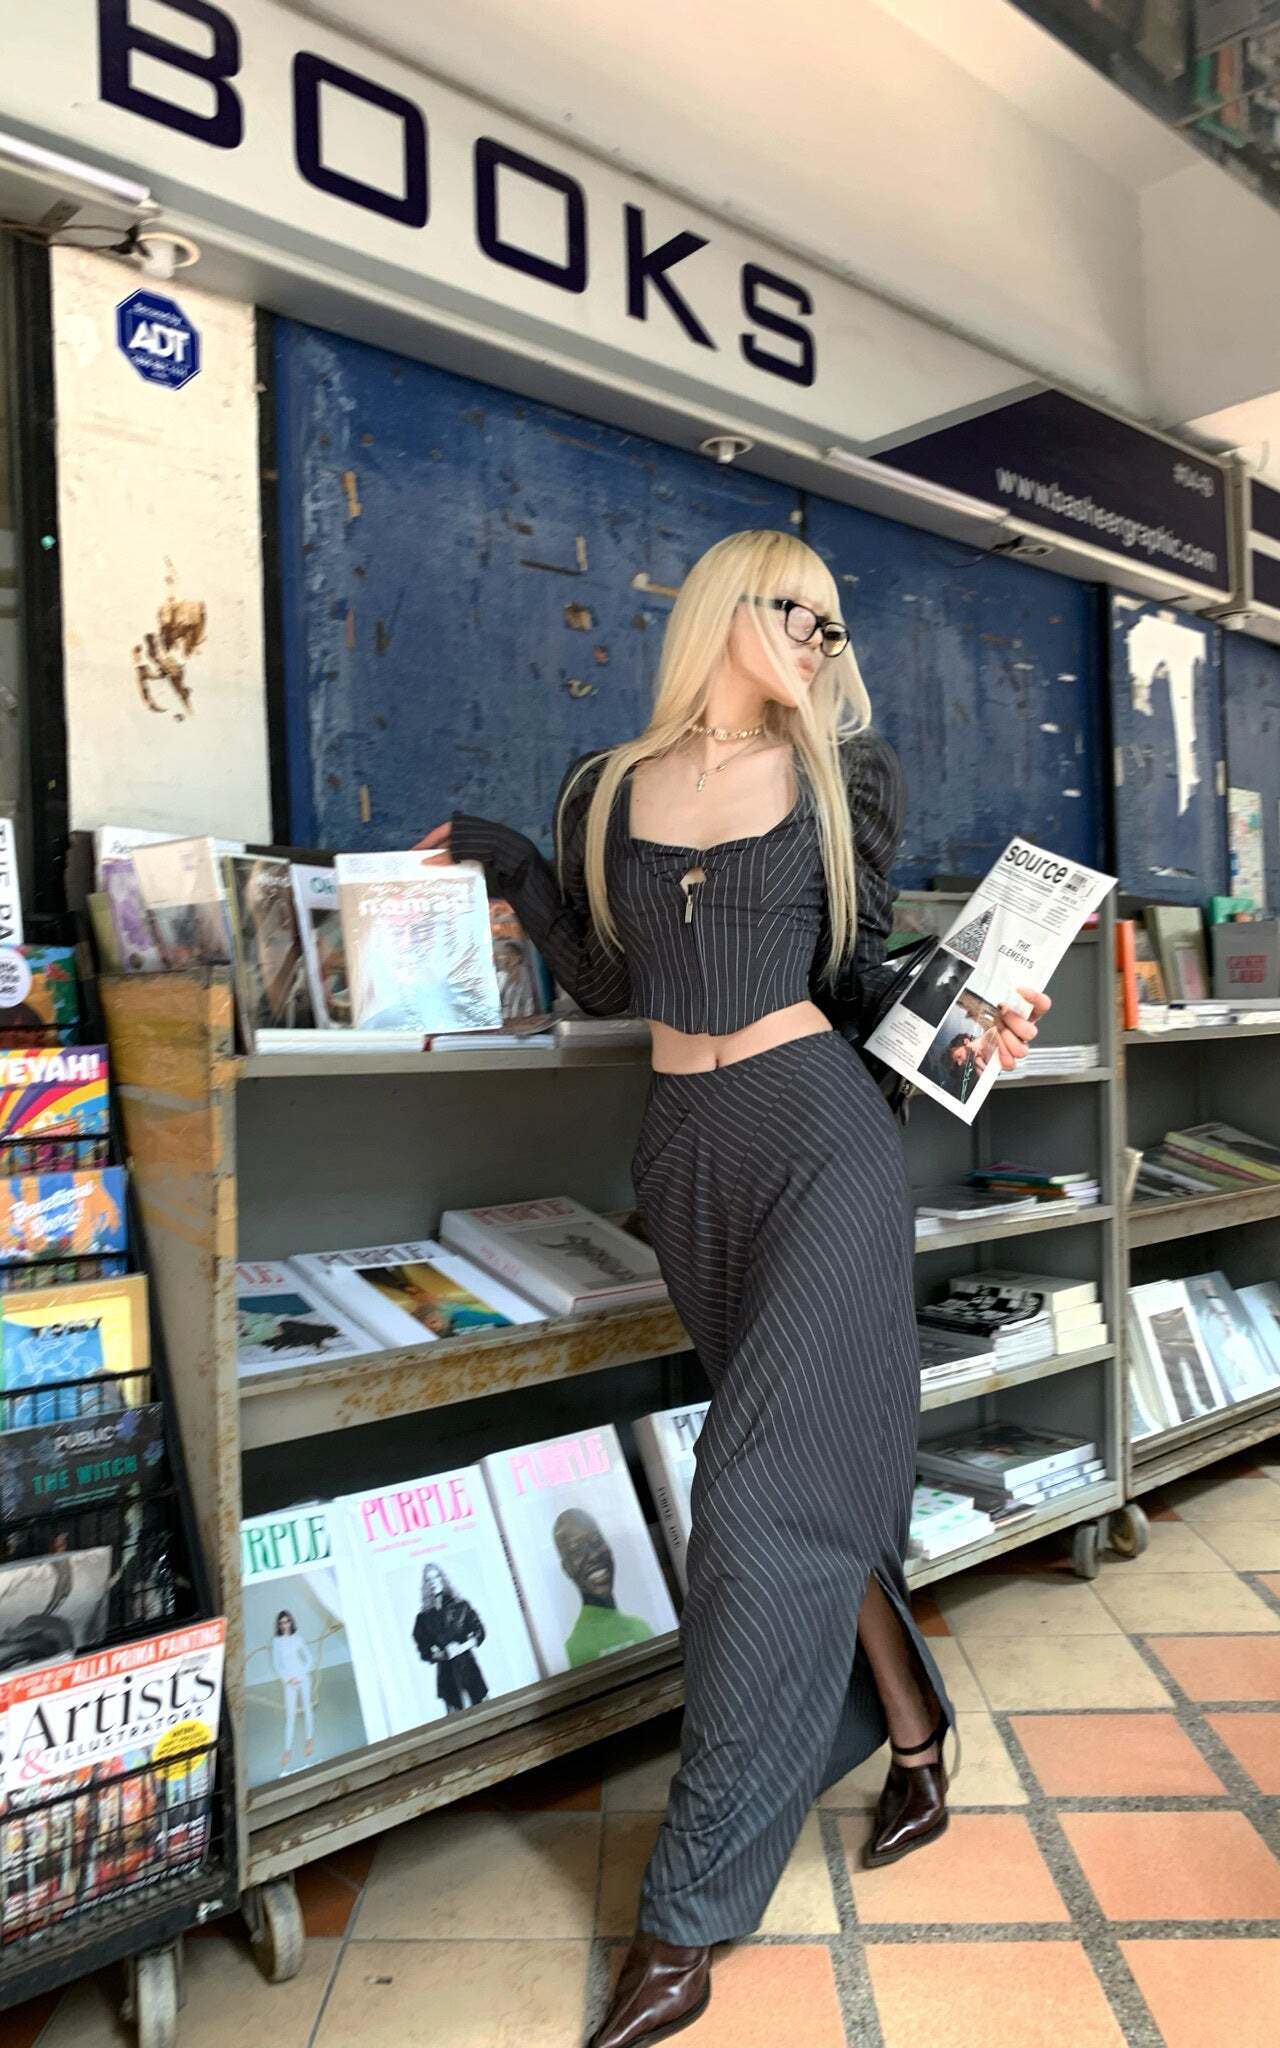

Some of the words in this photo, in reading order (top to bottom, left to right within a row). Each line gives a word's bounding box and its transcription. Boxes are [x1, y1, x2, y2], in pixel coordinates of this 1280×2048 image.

[98, 0, 817, 388] BOOKS
[128, 319, 191, 362] ADT
[1004, 845, 1069, 884] source
[997, 943, 1036, 971] ELEMENTS
[1015, 939, 1032, 953] THE
[32, 1469, 70, 1495] THE
[76, 1454, 138, 1485] WITCH
[507, 1433, 610, 1496] PURPLE
[359, 1476, 475, 1543] PURPLE
[241, 1514, 332, 1576] RPLE
[71, 1652, 110, 1687] ALLA
[111, 1643, 156, 1675] PRIMA
[13, 1670, 217, 1760] Artists
[18, 1747, 49, 1781] &
[54, 1705, 204, 1763] ILLUSTRATORS
